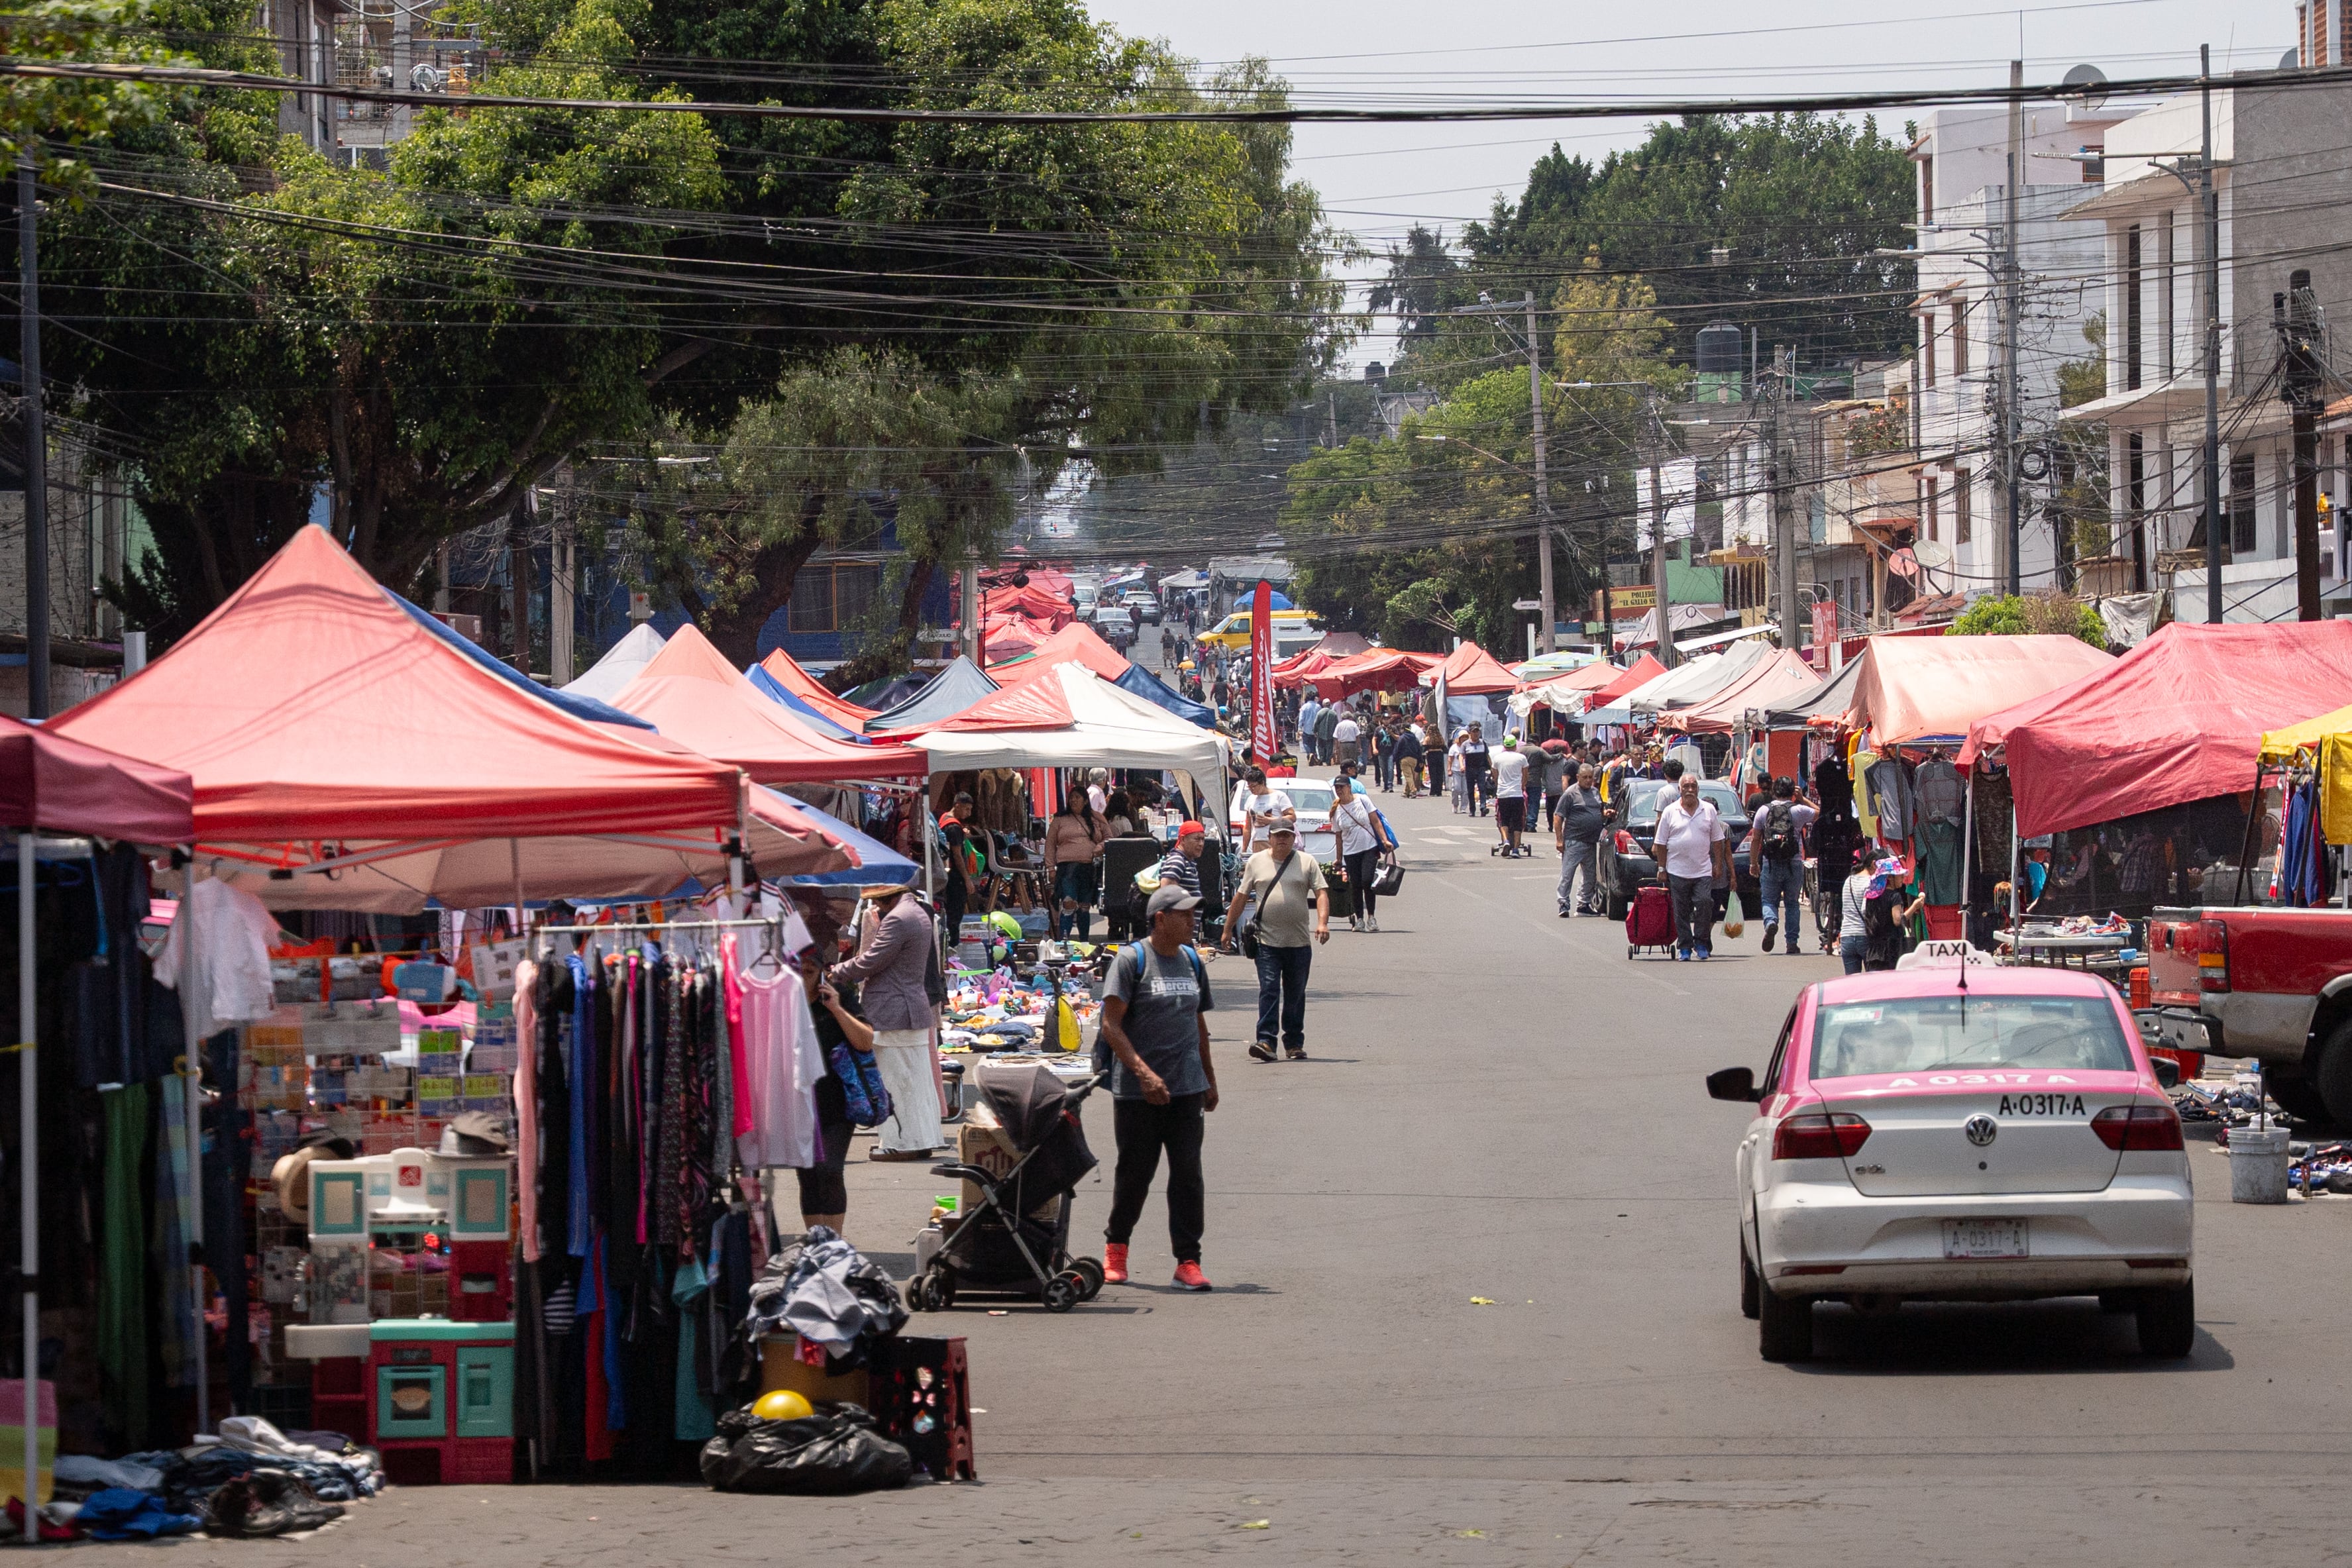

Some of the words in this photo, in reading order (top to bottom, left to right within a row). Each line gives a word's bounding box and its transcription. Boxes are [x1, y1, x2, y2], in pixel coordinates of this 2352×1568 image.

[1926, 943, 1967, 957] TAXI
[1889, 1078, 1919, 1088] A
[1929, 1074, 2031, 1084] 0317
[2047, 1074, 2078, 1084] A
[1953, 1230, 2020, 1247] A-0317-A
